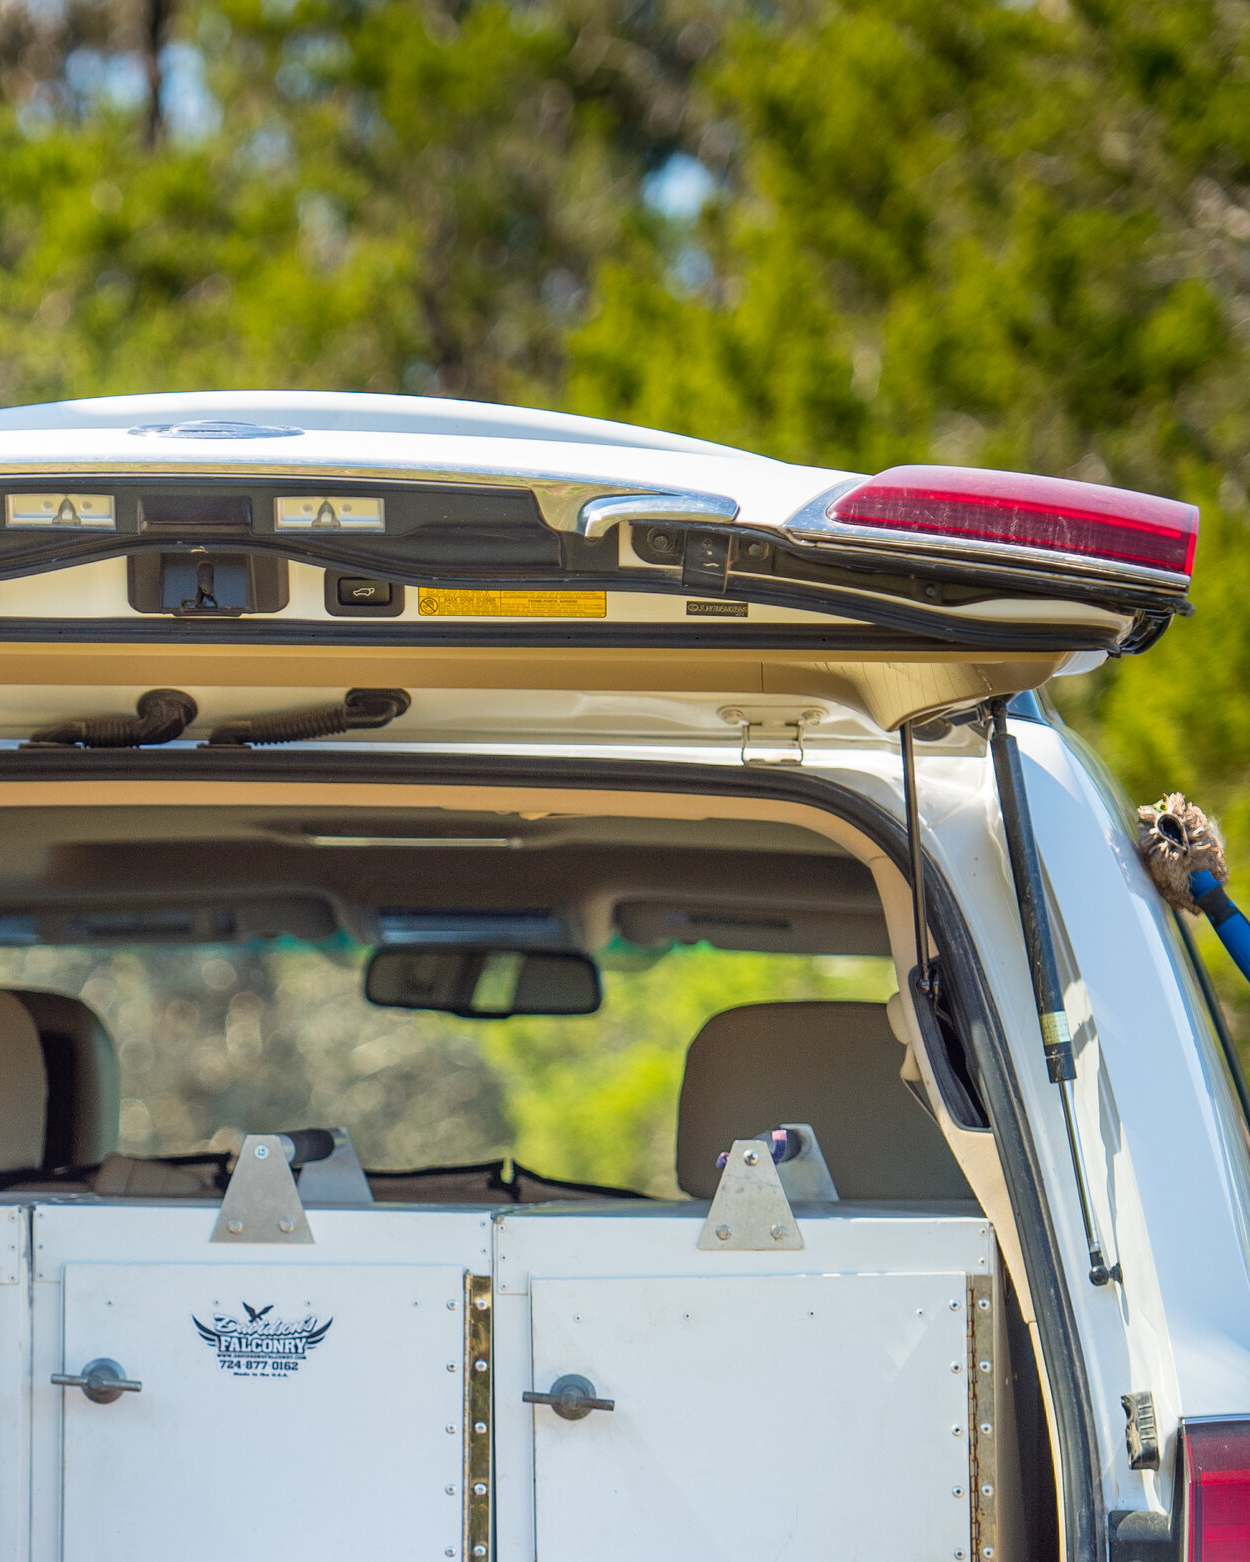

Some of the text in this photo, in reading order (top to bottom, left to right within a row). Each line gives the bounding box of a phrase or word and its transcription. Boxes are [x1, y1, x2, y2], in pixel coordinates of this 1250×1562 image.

[213, 1312, 317, 1337] Davidson's
[218, 1336, 307, 1354] FALCONRY
[219, 1359, 299, 1371] 724 877 0162
